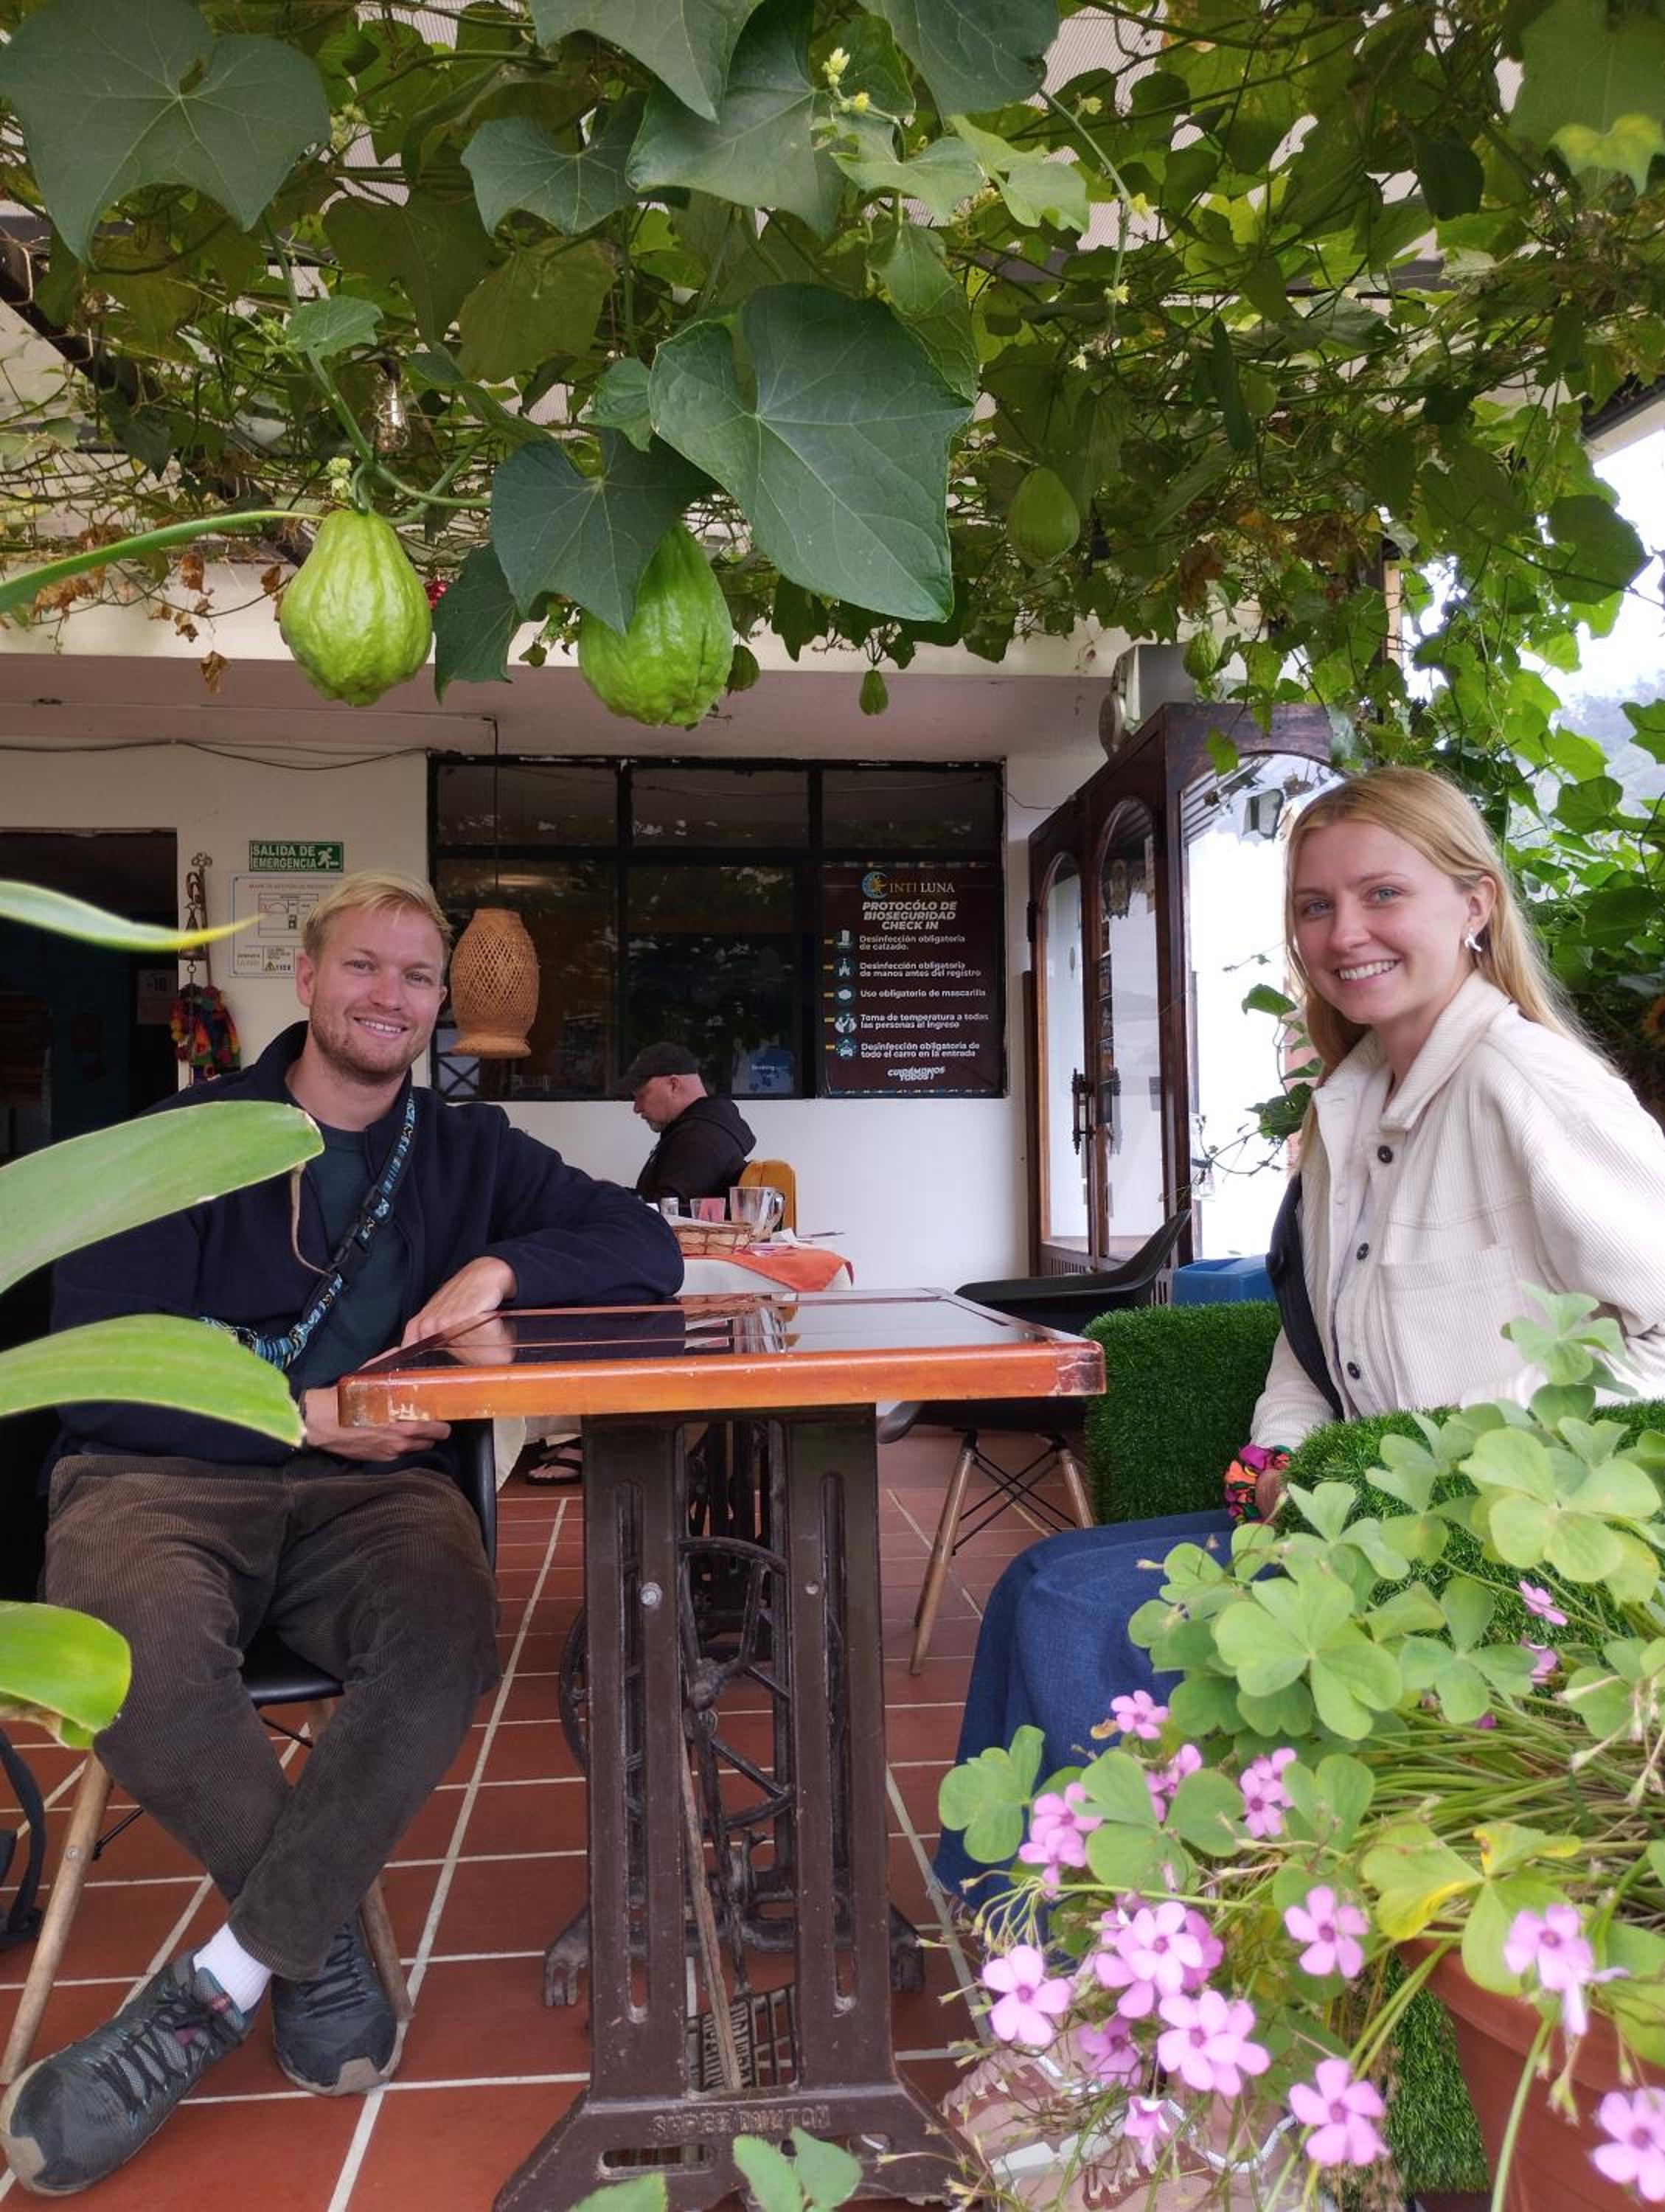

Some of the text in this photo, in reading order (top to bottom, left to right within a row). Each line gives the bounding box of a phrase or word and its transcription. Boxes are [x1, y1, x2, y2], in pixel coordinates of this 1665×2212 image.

[252, 846, 316, 856] SALIDA DE
[253, 858, 317, 869] EMERGENCIA
[889, 883, 955, 893] INTI LUNA
[862, 900, 958, 911] PROTOCÓLO DE
[863, 911, 956, 921] BIOSEGURIDAD
[881, 921, 939, 930] CHECK IN
[859, 935, 917, 943] Desinfección
[859, 961, 917, 970] Desinfección
[931, 969, 945, 977] del
[861, 990, 877, 998] Uso
[900, 1014, 955, 1023] temperatura
[875, 1022, 915, 1030] personas
[861, 1042, 918, 1050] Desinfección
[861, 1050, 883, 1058] todo
[884, 1050, 891, 1058] el
[931, 1049, 940, 1057] la
